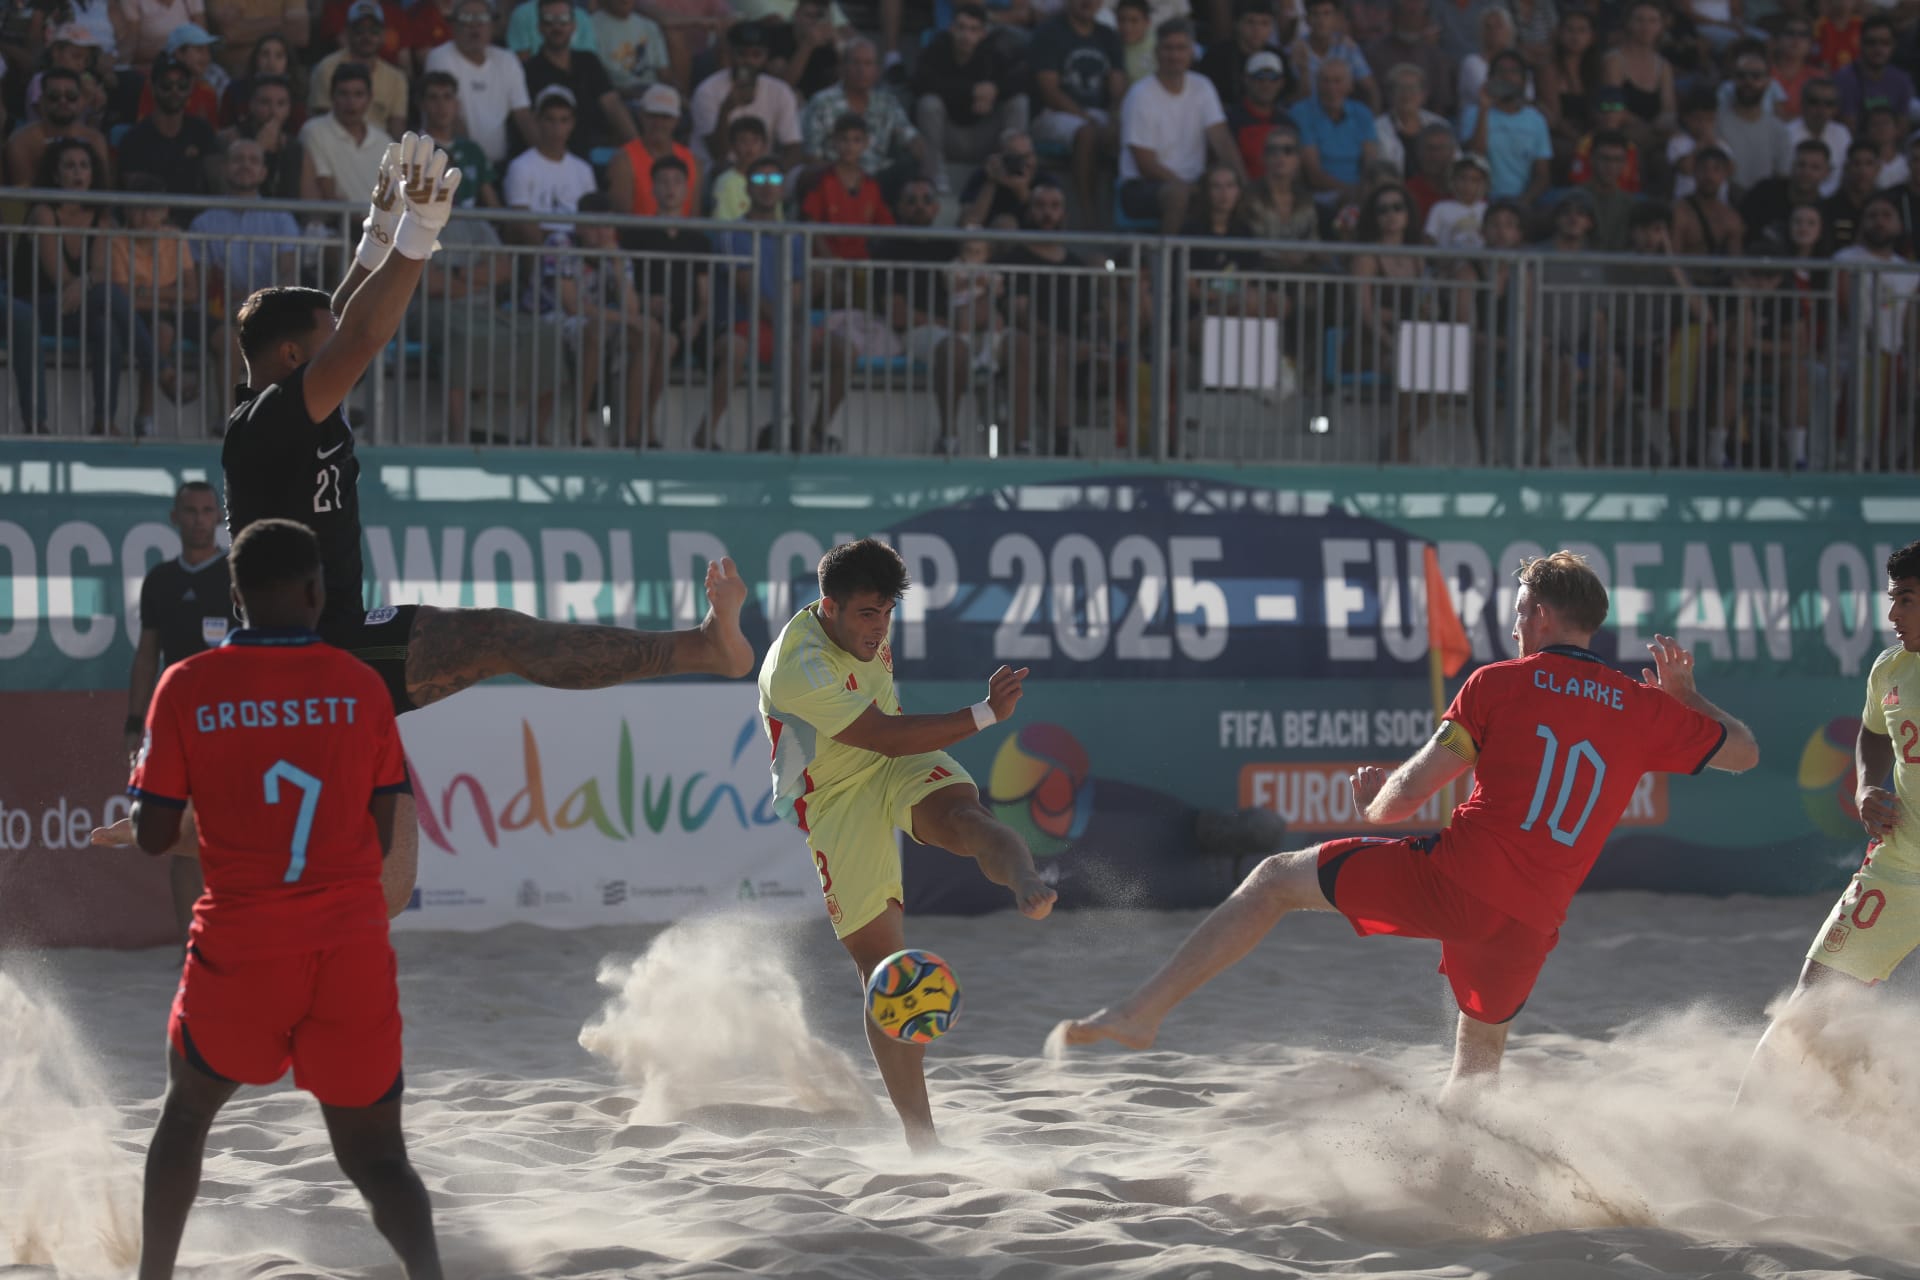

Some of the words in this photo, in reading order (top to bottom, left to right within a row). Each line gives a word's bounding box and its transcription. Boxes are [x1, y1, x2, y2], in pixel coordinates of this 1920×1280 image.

[313, 464, 343, 513] 21
[768, 531, 958, 660] CP
[988, 533, 1229, 661] 2025
[196, 698, 357, 732] GROSSETT
[1534, 669, 1624, 710] CLARKE
[1219, 711, 1276, 748] FIFA
[1283, 710, 1369, 748] BEACH
[1519, 724, 1607, 847] 10
[41, 796, 92, 850] de
[263, 759, 322, 882] 7
